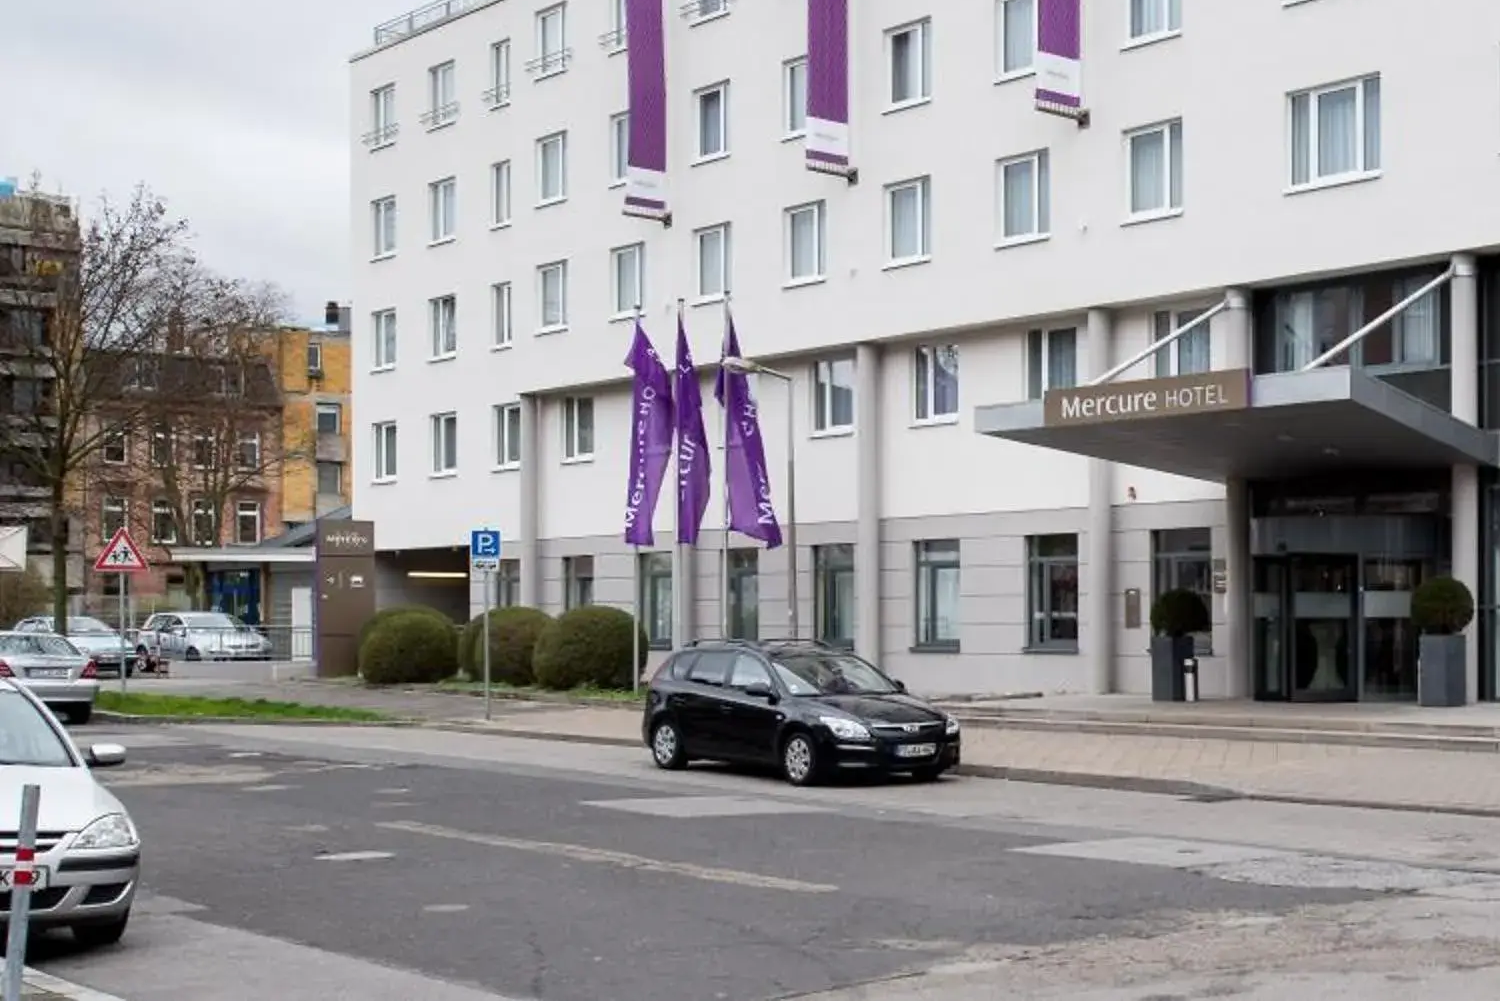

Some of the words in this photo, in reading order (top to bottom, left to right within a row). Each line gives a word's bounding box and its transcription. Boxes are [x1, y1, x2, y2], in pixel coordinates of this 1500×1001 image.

[1060, 390, 1158, 420] Mercure
[1164, 384, 1229, 408] HOTEL
[477, 534, 493, 554] P
